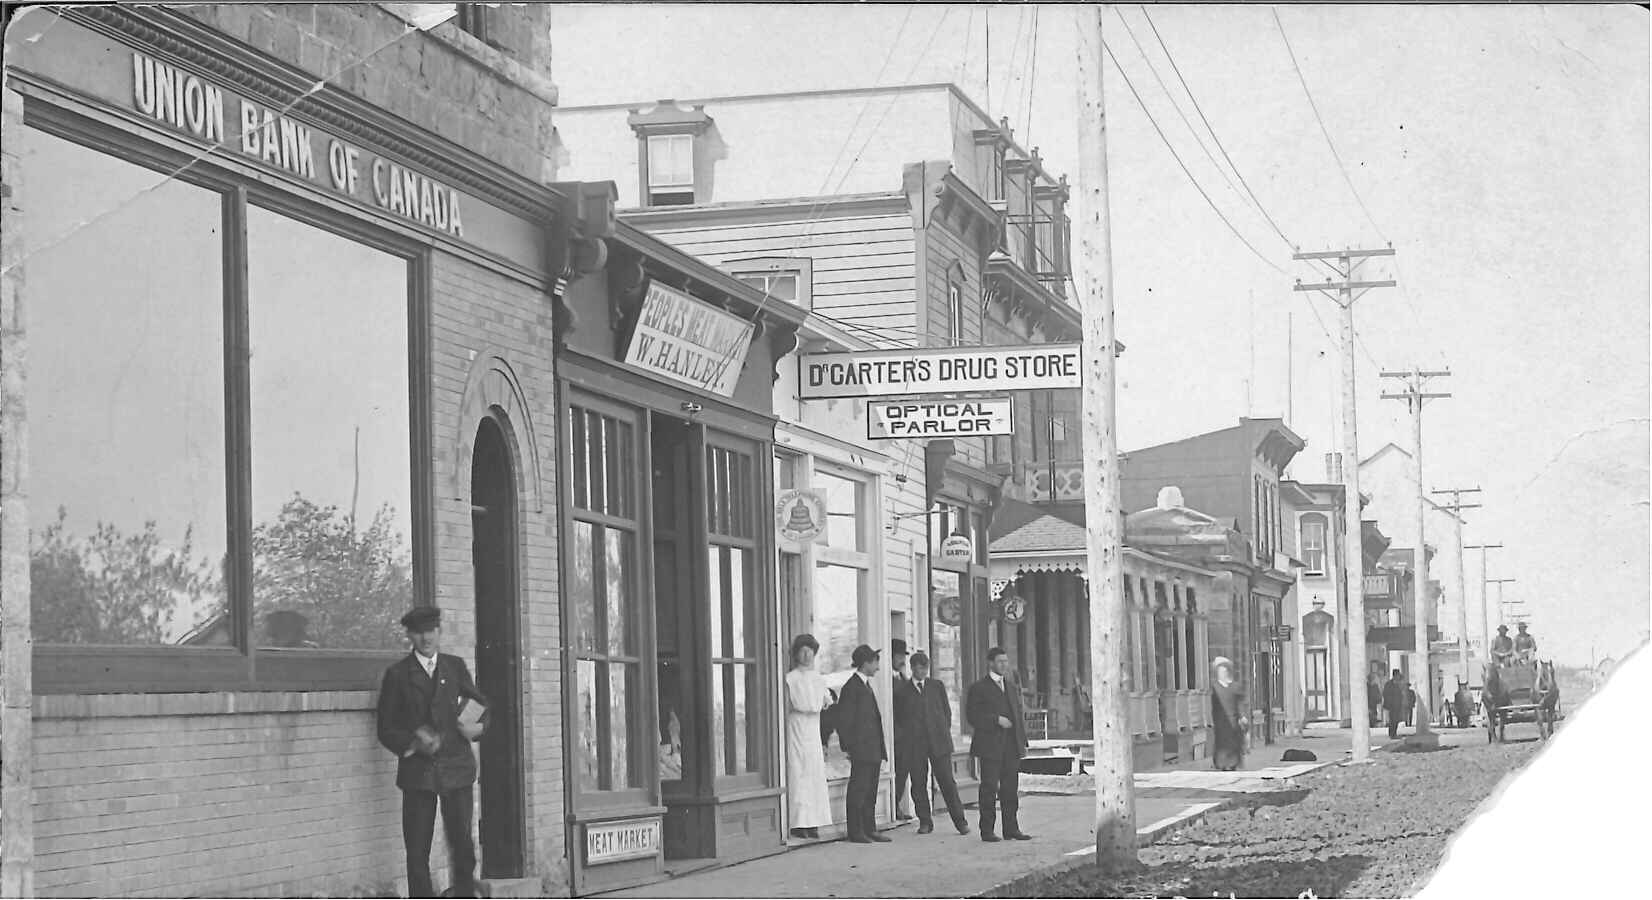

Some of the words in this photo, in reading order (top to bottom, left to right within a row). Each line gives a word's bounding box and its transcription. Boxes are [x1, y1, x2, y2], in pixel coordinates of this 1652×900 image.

[133, 52, 224, 143] UNION
[241, 100, 316, 179] BANK
[329, 139, 359, 194] OF
[373, 158, 463, 237] CANADA
[939, 357, 998, 381] DRUG
[1005, 353, 1076, 378] STORE
[886, 403, 993, 418] OPTICAL
[890, 419, 991, 434] PARLOR
[589, 831, 614, 856] MEAT
